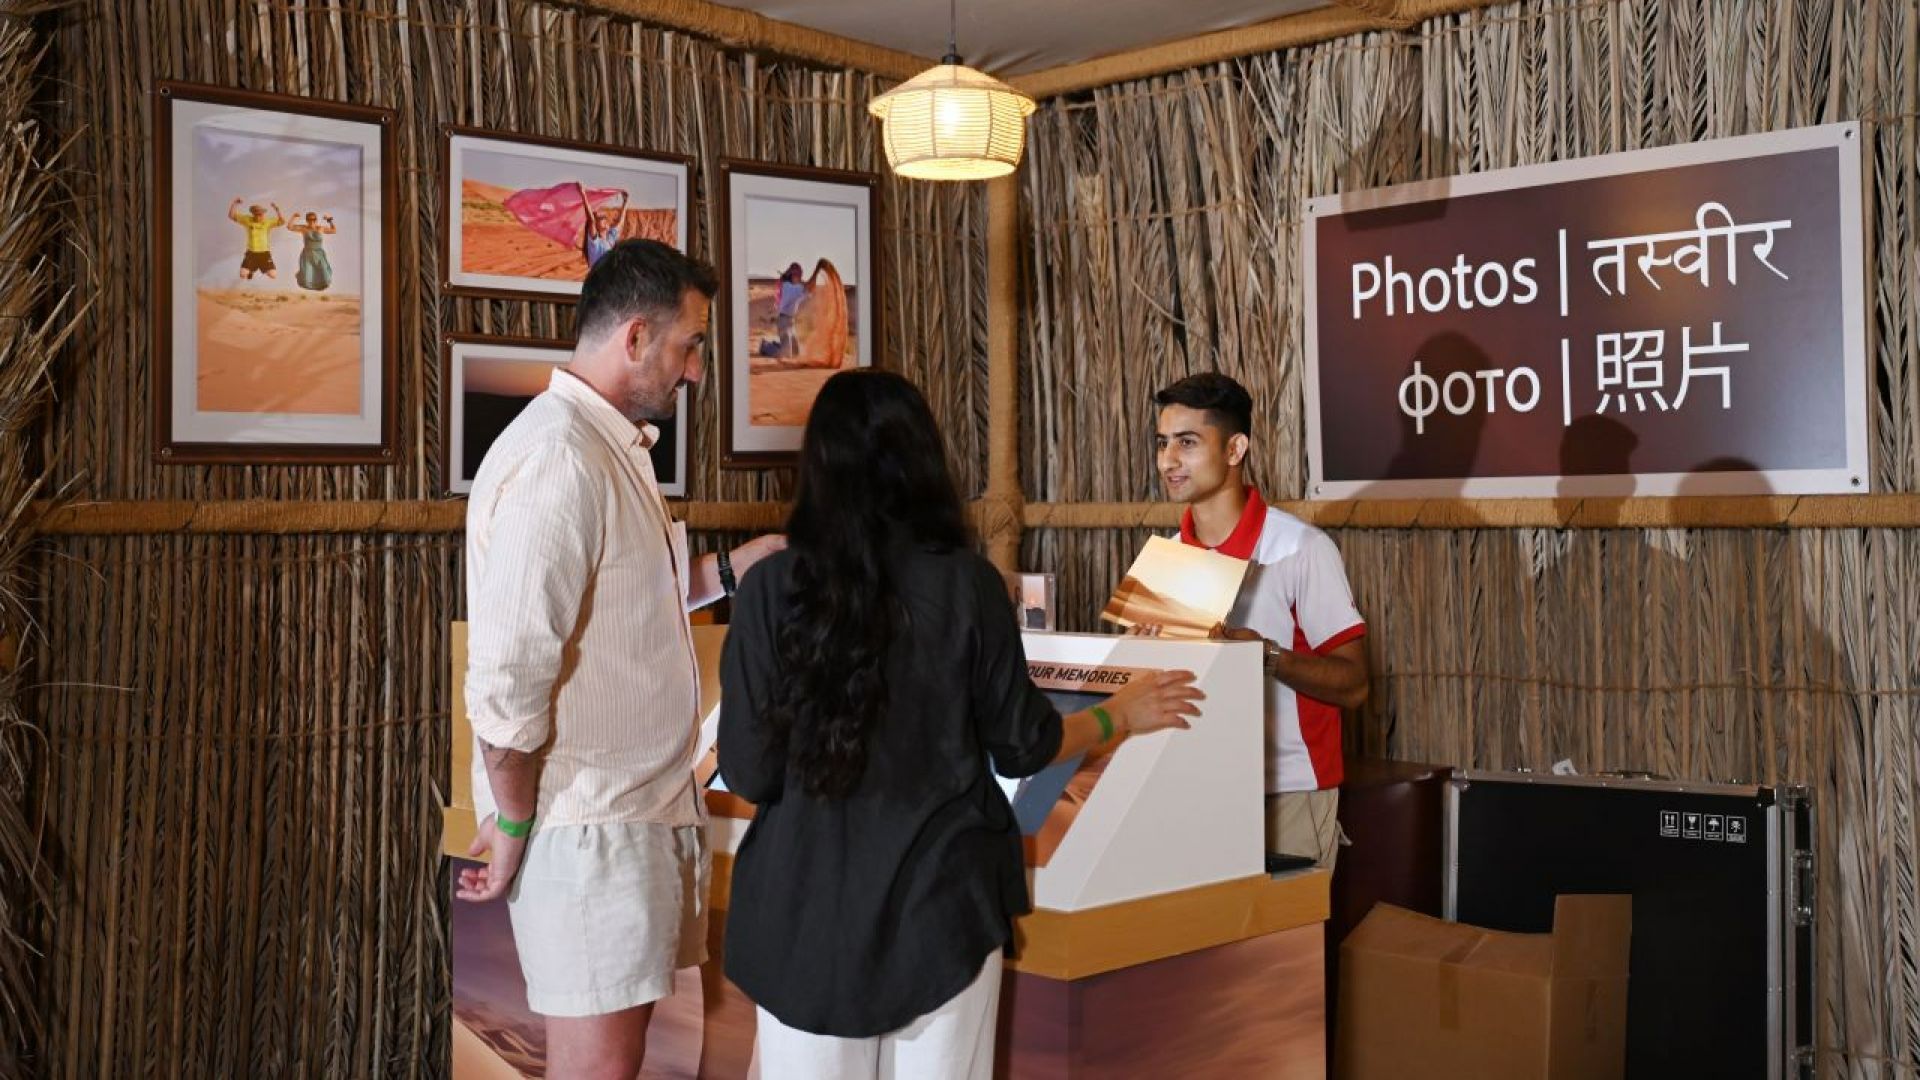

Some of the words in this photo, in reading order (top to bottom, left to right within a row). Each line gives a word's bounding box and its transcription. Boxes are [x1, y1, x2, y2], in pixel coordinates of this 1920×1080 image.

[1587, 202, 1792, 296] तस्वीर
[1353, 254, 1538, 319] Photos
[1399, 361, 1541, 434] фото
[1595, 322, 1750, 413] 照片
[1055, 667, 1132, 684] MEMORIES
